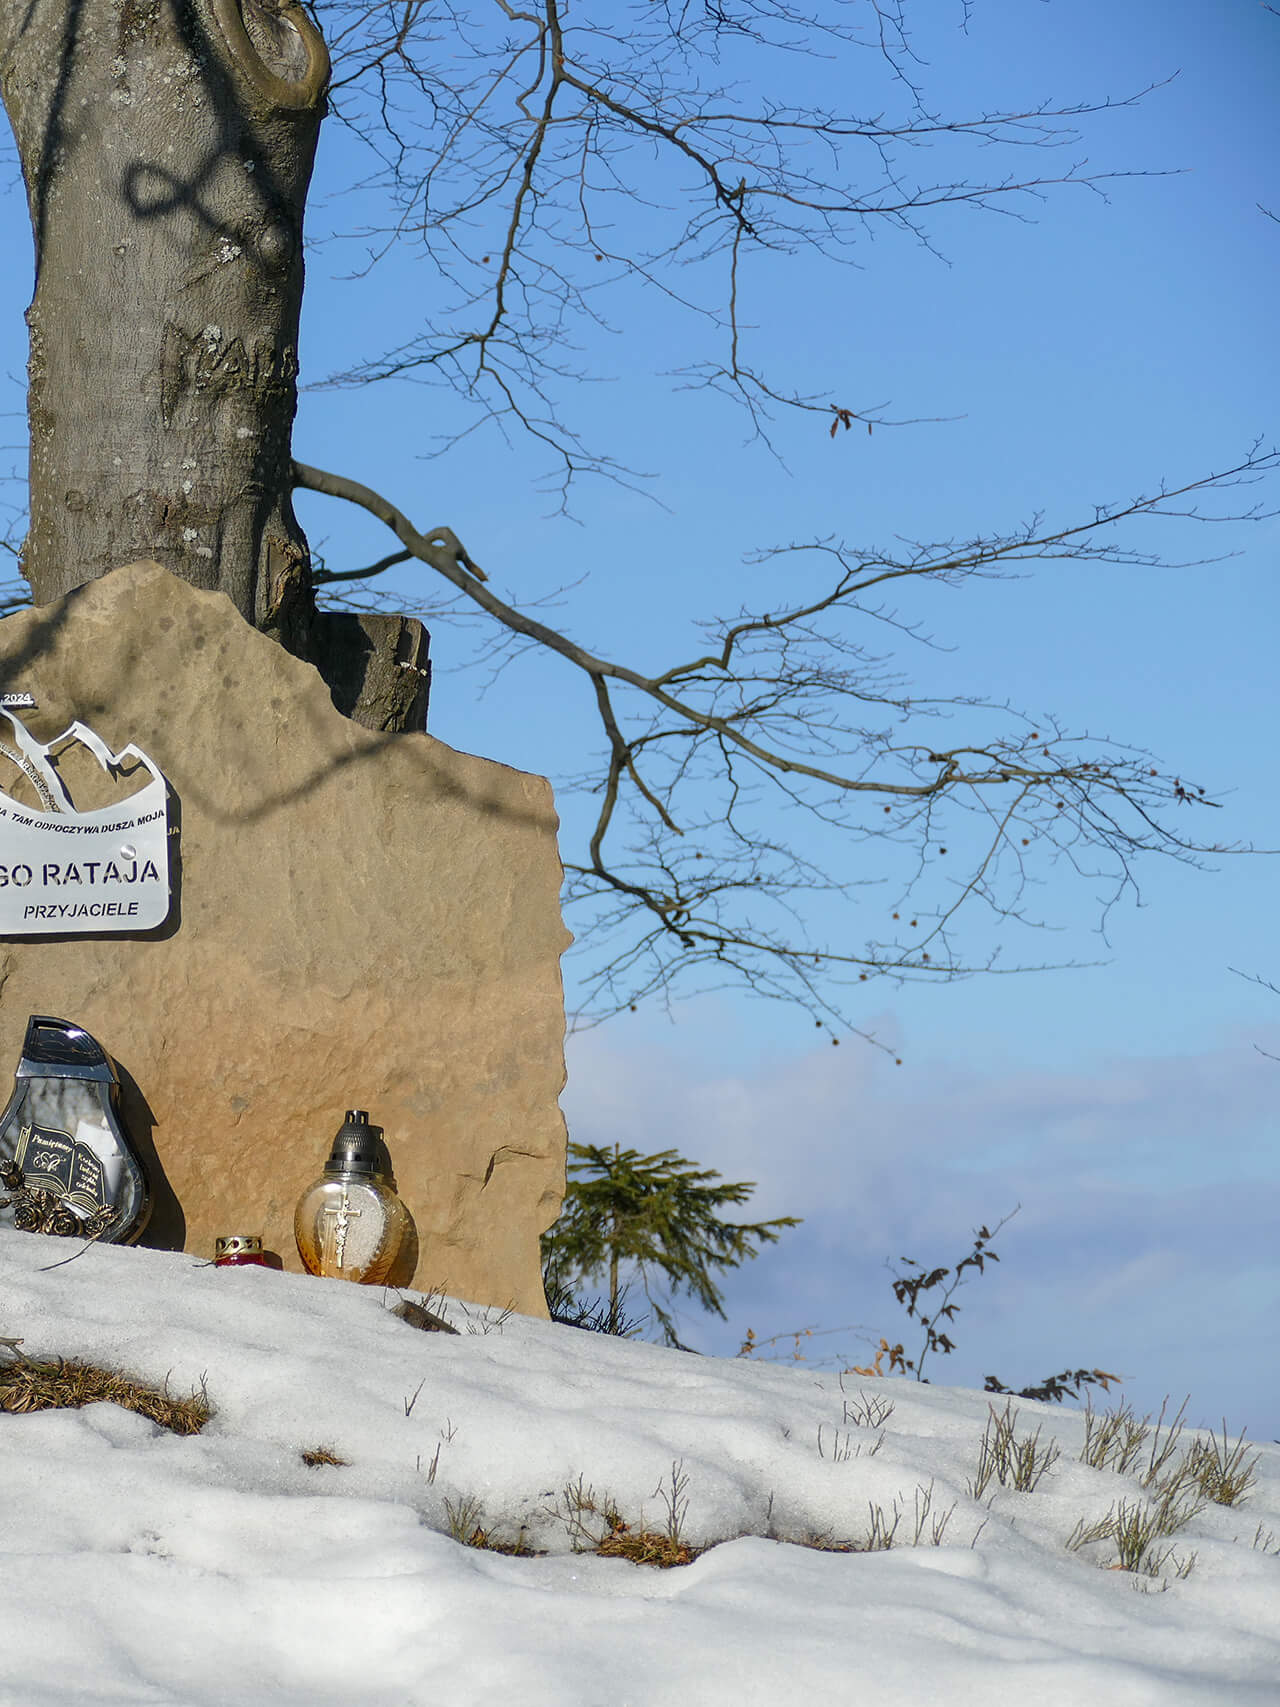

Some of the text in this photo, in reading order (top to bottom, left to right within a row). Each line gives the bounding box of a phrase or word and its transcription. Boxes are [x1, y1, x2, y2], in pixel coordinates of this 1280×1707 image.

[11, 813, 34, 826] TAM
[34, 820, 100, 834] ODPOCZYWA
[101, 820, 135, 833] DUSZA
[137, 809, 165, 826] MOJA
[42, 859, 160, 888] RATAJA
[23, 902, 139, 920] PRZYJACIELE
